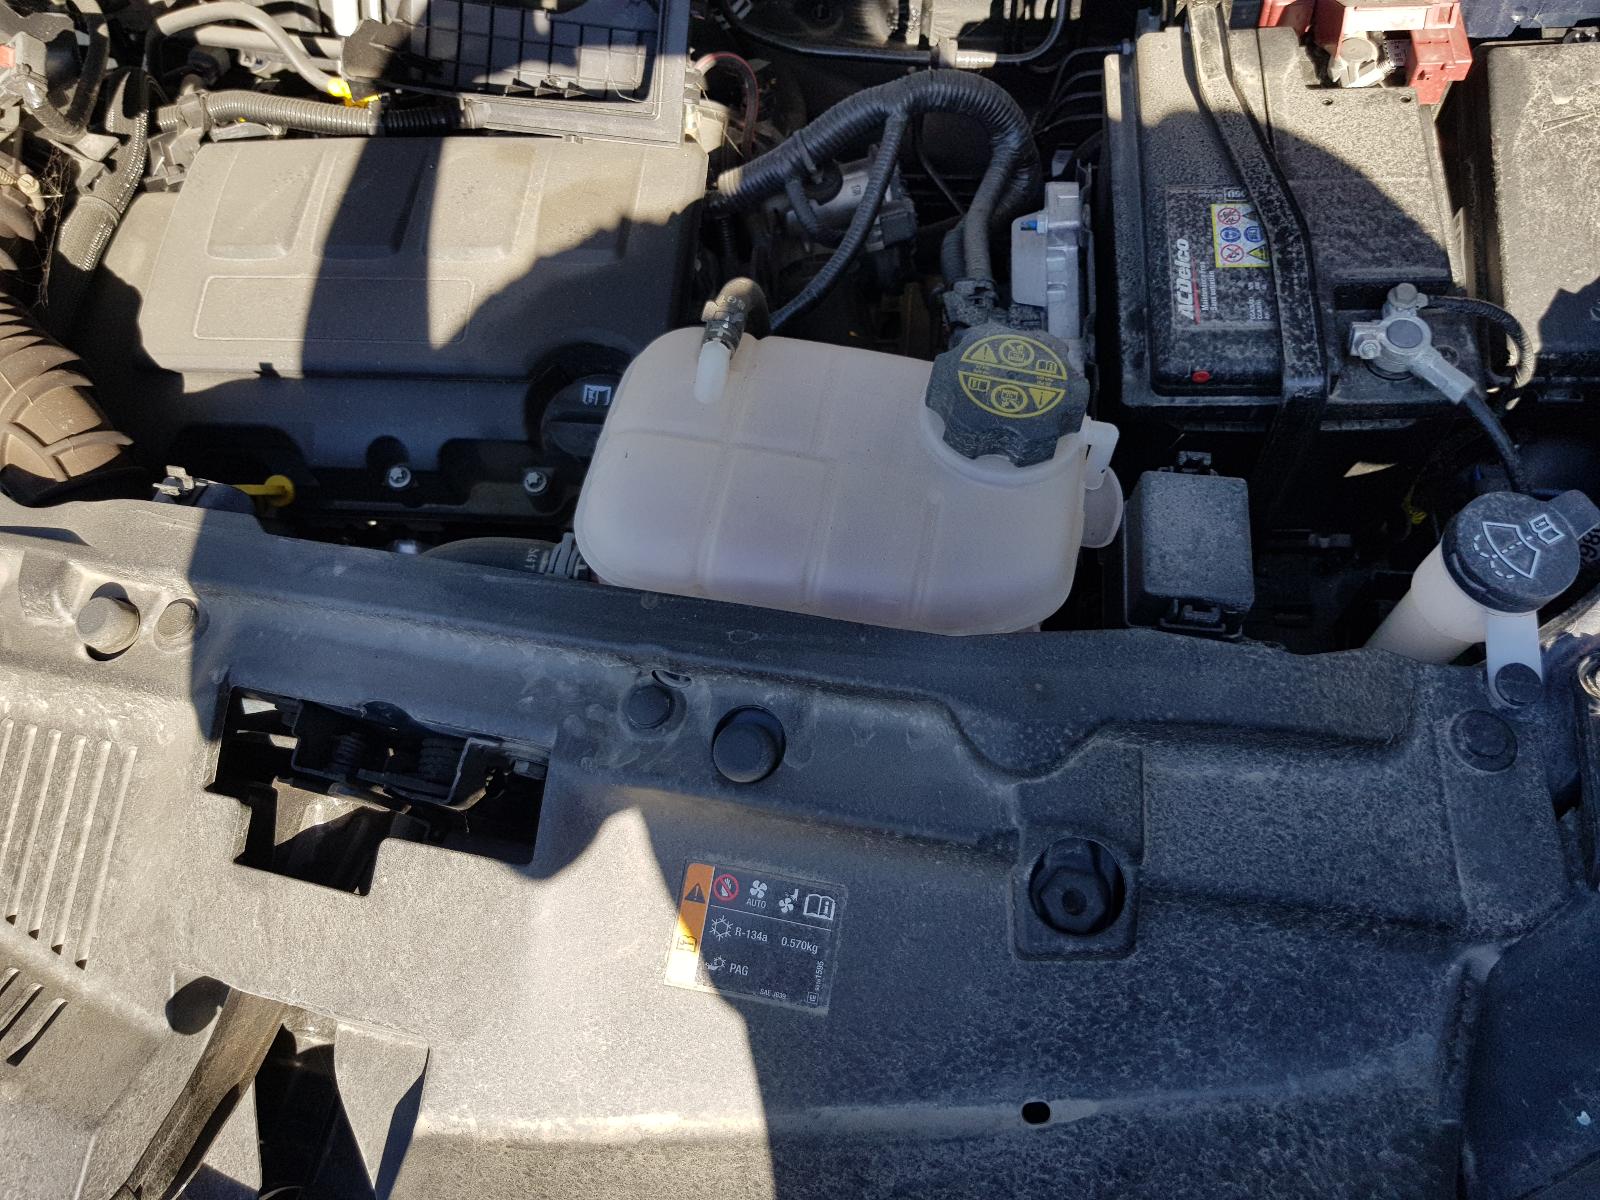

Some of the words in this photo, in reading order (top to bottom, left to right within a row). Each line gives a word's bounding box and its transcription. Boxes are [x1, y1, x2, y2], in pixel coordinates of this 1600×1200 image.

[1175, 238, 1194, 320] ACDelco
[746, 898, 767, 909] AUTO
[735, 927, 768, 942] R-134a
[781, 936, 819, 955] 0.570kg
[729, 963, 749, 976] PAG
